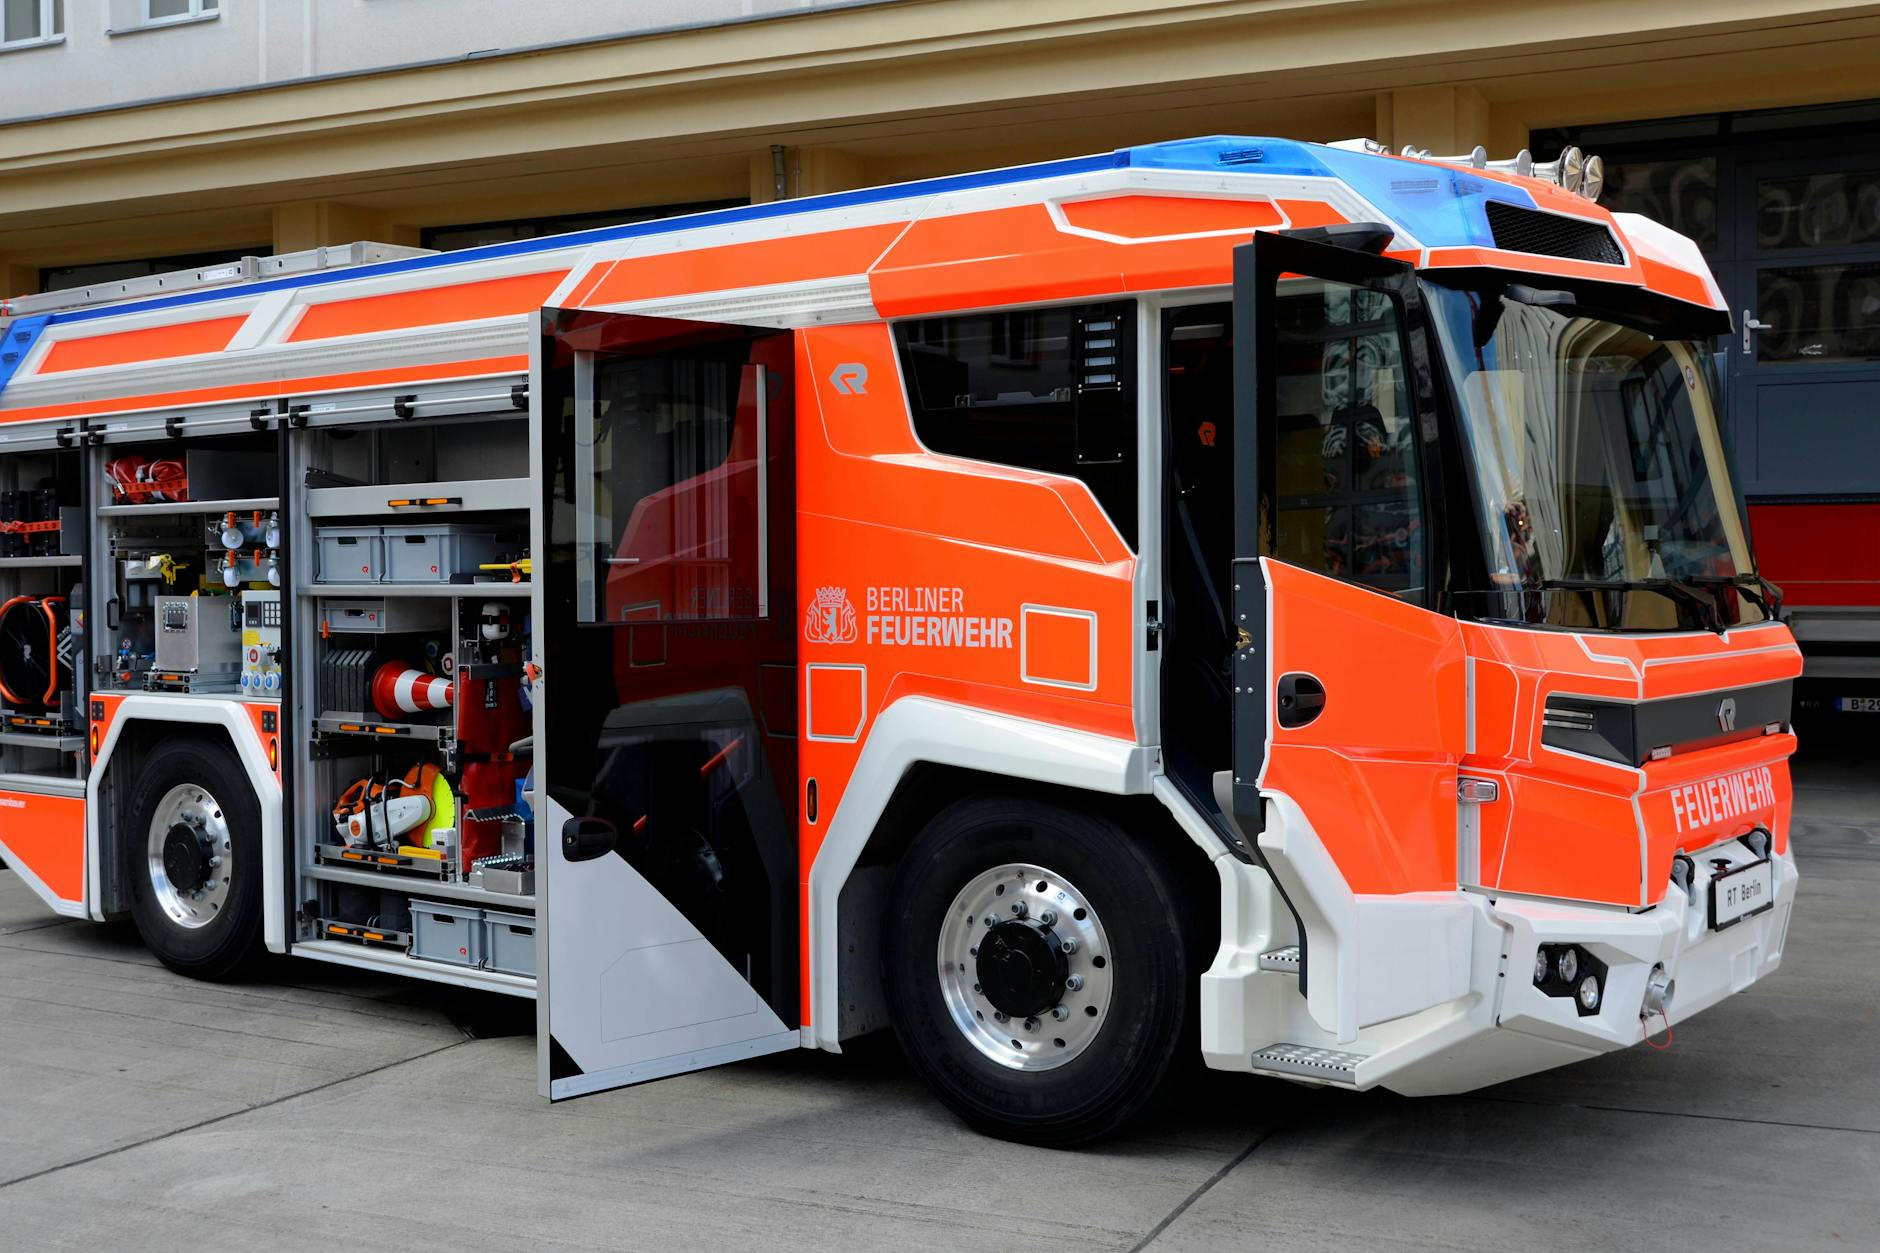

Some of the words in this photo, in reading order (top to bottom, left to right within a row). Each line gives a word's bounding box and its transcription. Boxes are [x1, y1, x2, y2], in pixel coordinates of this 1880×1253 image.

[866, 586, 964, 613] BERLINER
[866, 615, 1013, 649] FEUERWEHR
[1670, 766, 1776, 833] FEUERWEHR
[1727, 886, 1737, 908] RT
[1741, 879, 1761, 901] Berlin
